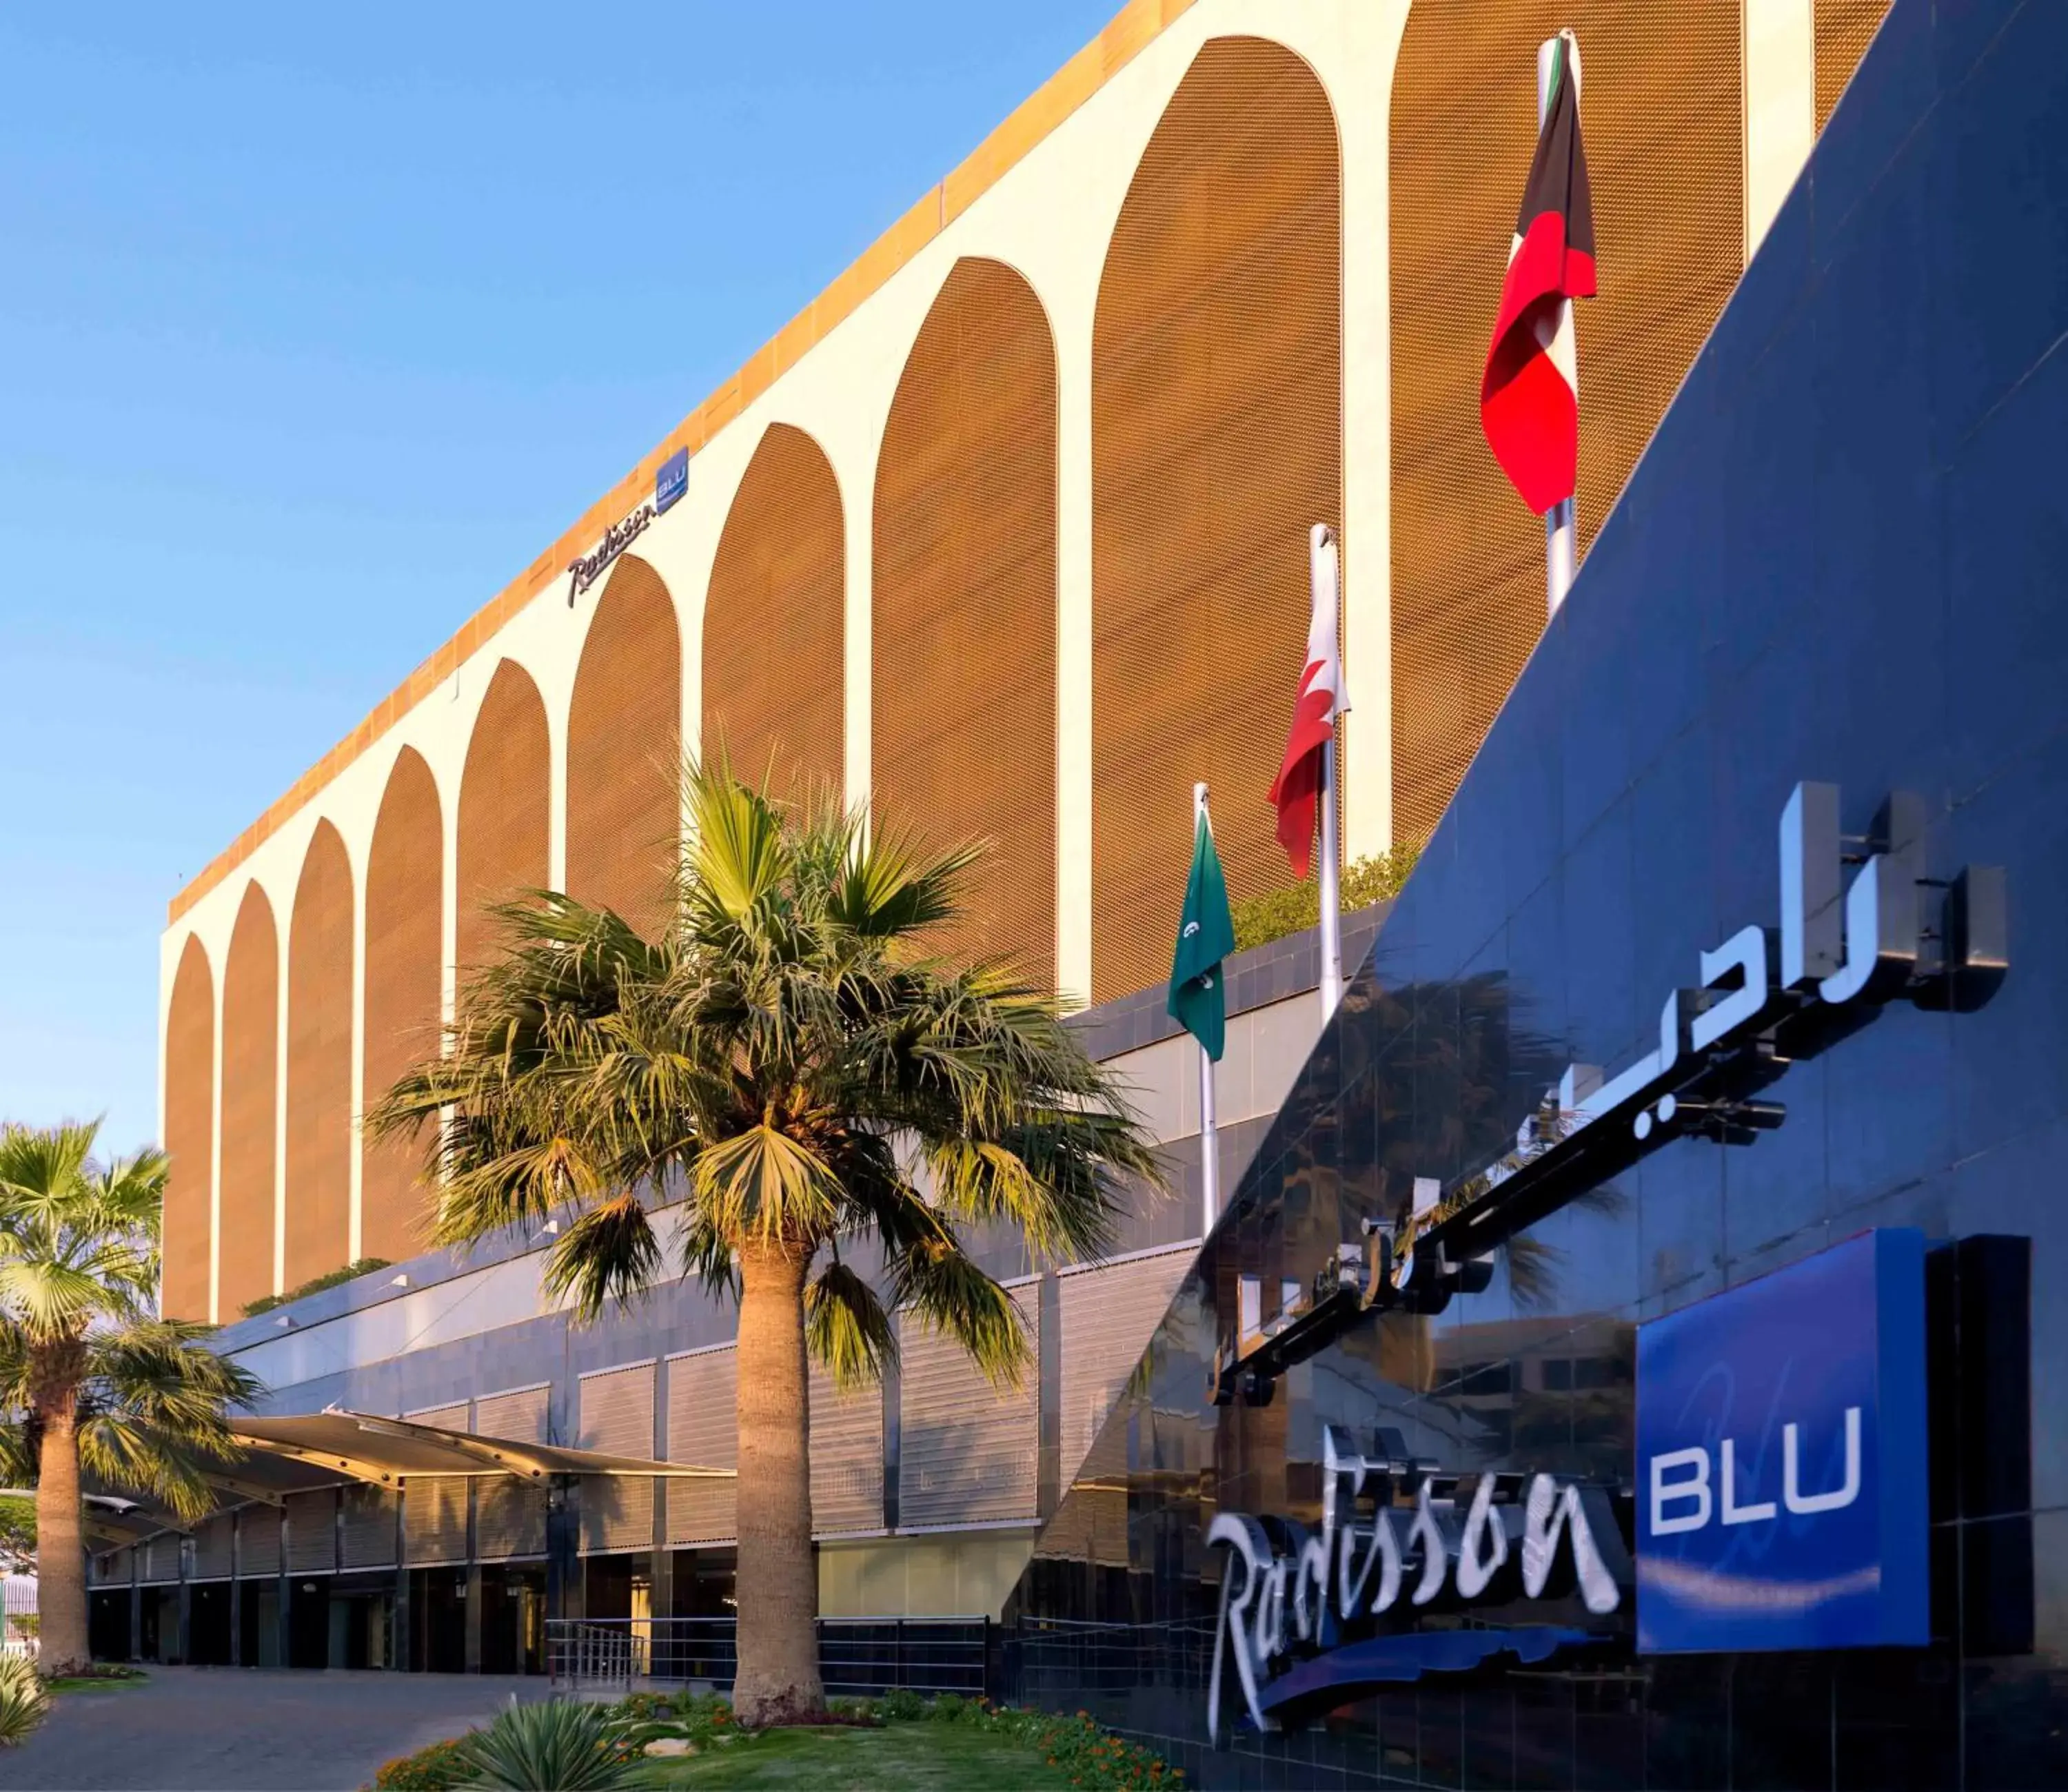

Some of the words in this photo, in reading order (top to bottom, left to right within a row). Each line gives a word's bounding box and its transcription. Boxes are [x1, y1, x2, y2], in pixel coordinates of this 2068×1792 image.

[568, 505, 657, 609] Radisson
[658, 465, 686, 498] BLU
[1207, 1424, 1620, 1751] Radisson
[1650, 1406, 1861, 1536] BLU
